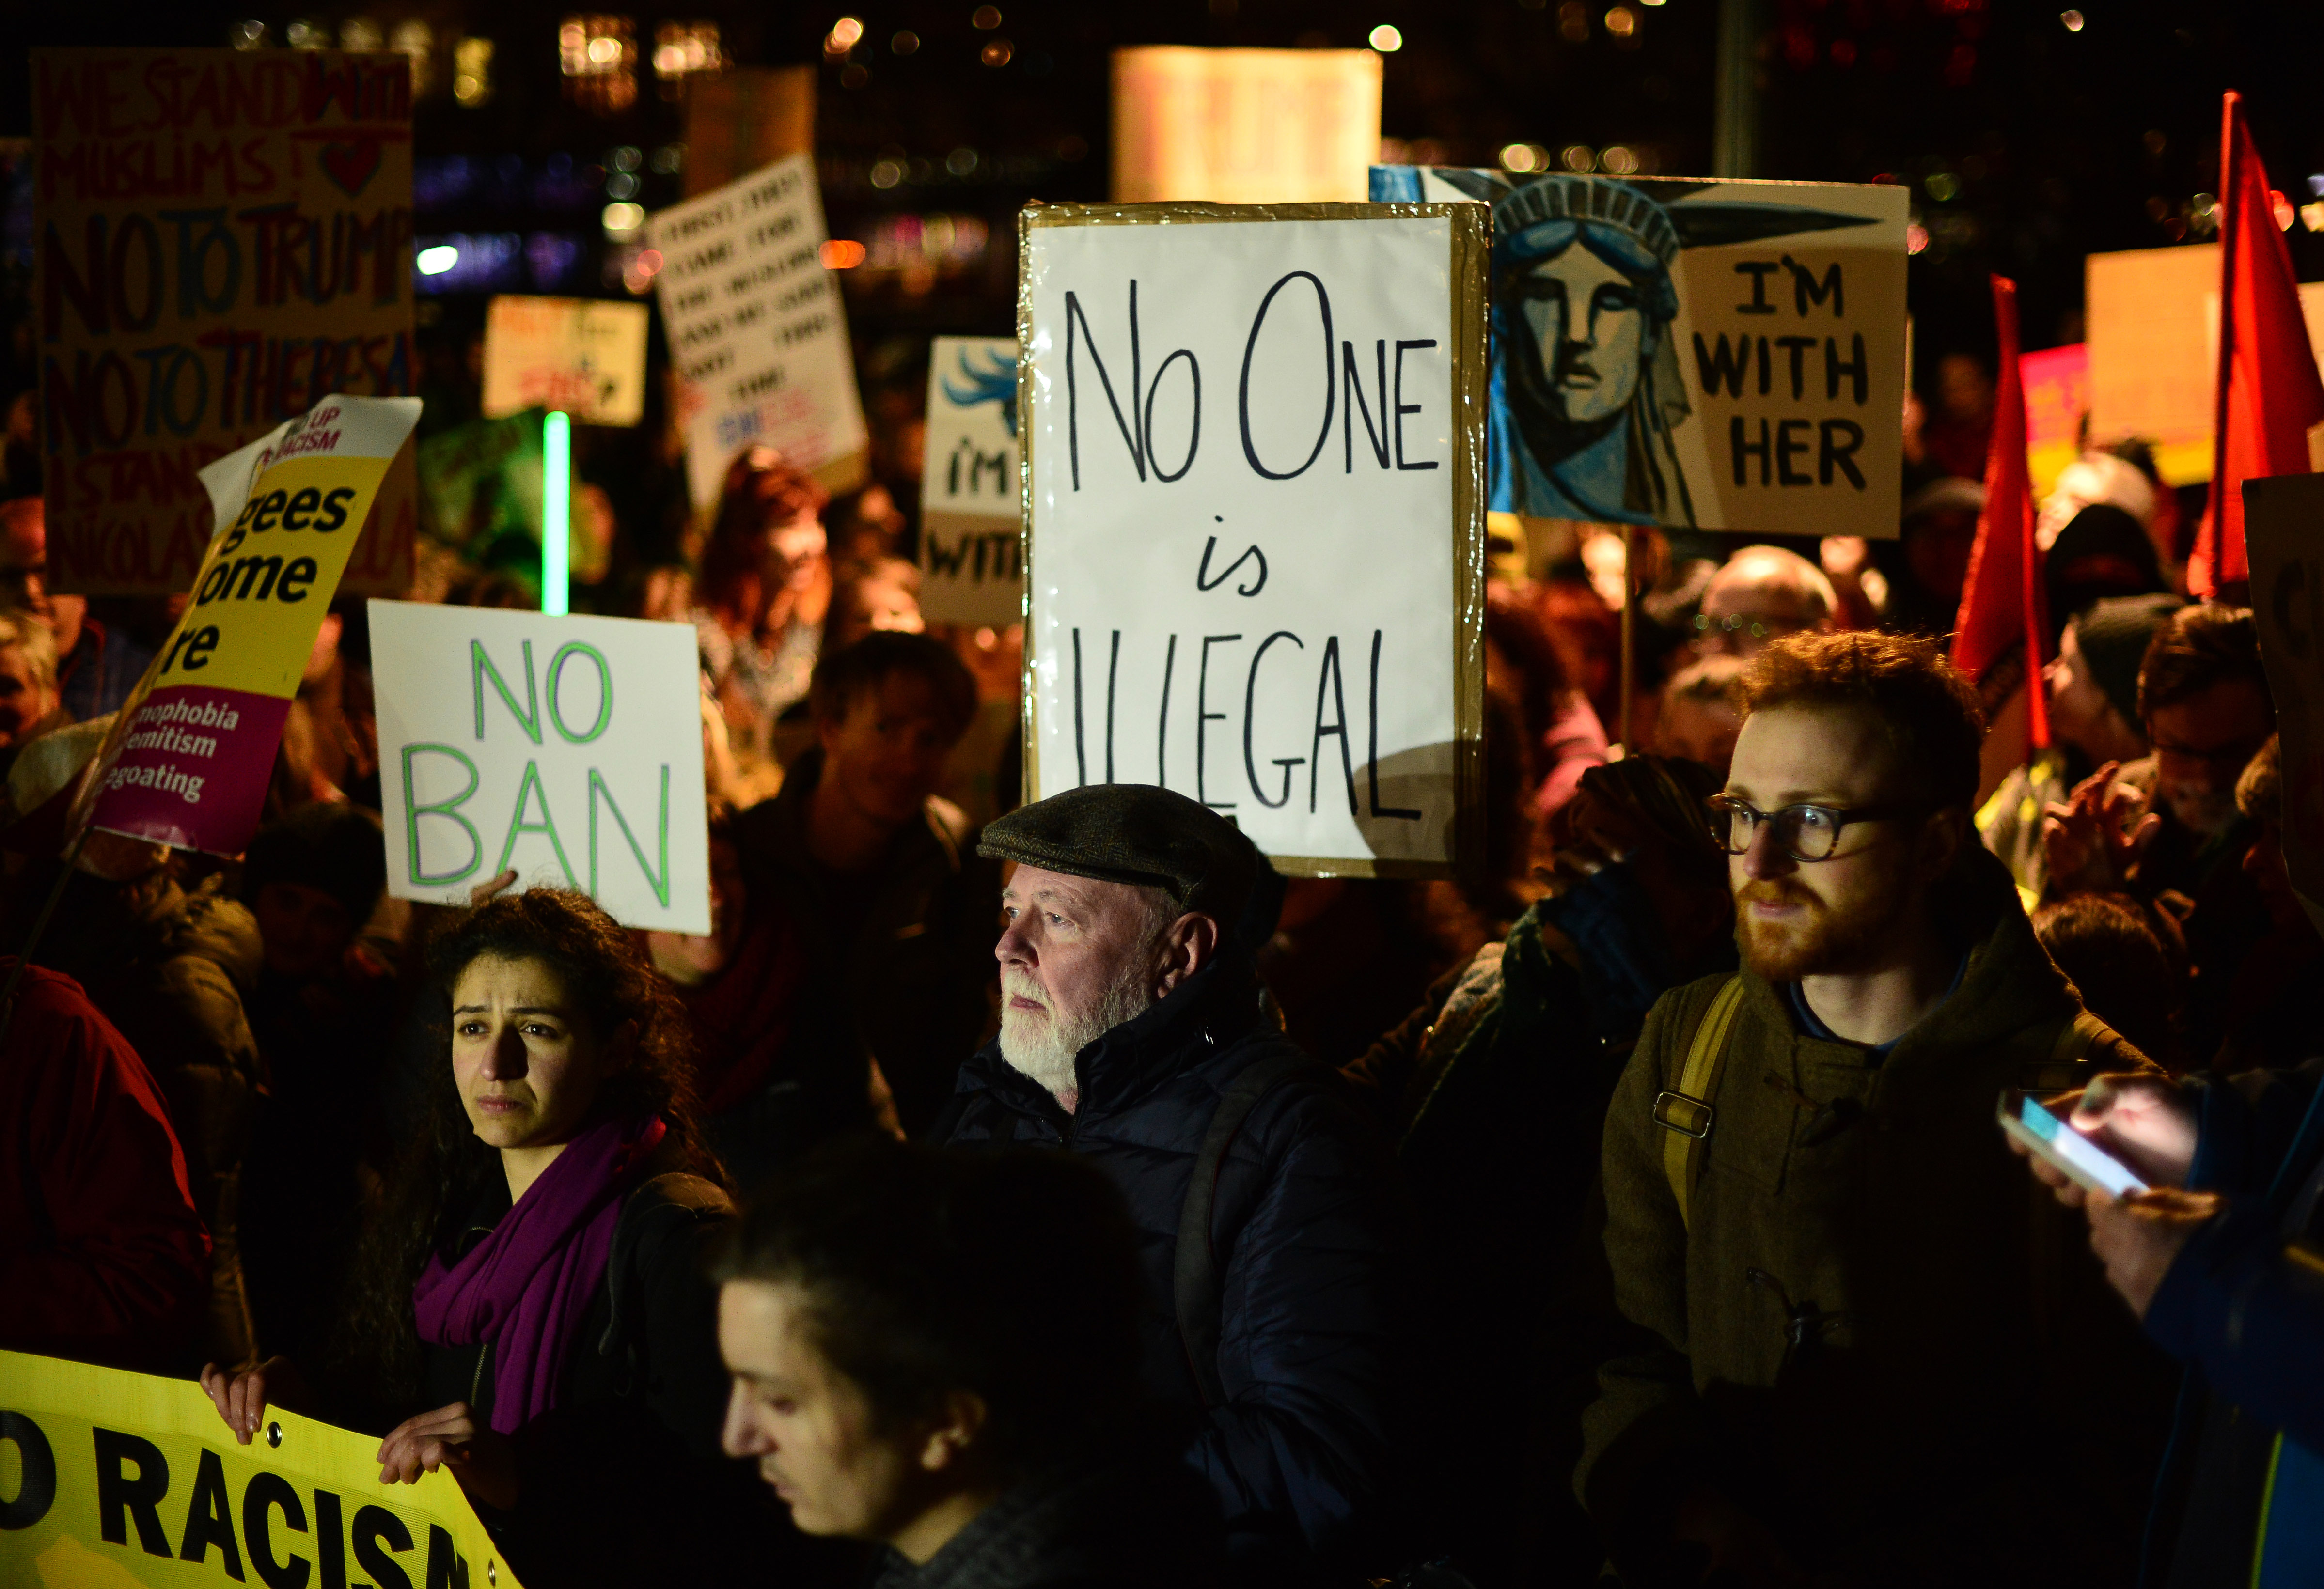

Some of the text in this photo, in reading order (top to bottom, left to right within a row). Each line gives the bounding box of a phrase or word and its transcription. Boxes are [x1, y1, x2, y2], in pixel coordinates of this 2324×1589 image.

[39, 57, 134, 140] WE
[44, 202, 415, 342] NO TO TRUMP
[1734, 254, 1844, 318] I'M
[45, 347, 138, 455] NO
[135, 343, 208, 437] TO
[1693, 331, 1869, 406] WITH
[1730, 416, 1868, 490] HER
[1196, 515, 1268, 597] is
[471, 639, 613, 745] NO
[401, 742, 670, 910] BAN
